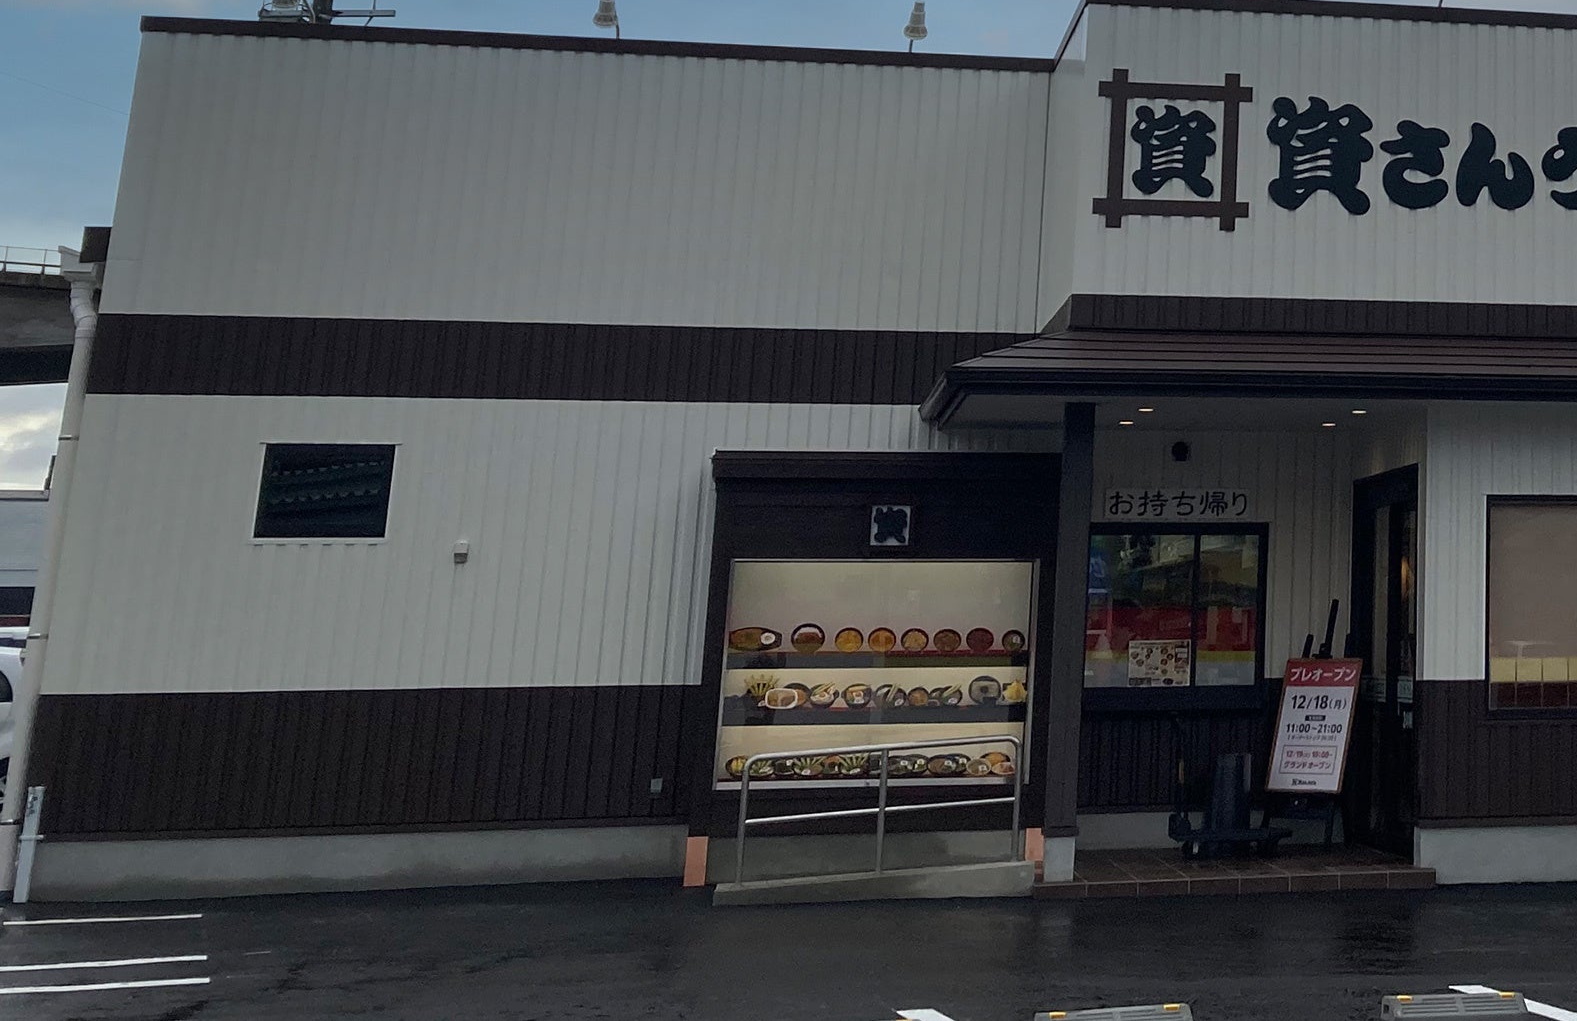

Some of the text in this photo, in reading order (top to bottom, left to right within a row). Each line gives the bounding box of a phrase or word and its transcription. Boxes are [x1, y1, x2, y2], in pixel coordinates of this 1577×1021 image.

[1130, 105, 1217, 198] 資
[1109, 490, 1248, 517] お持ち帰り
[1290, 666, 1357, 682] プレオープン
